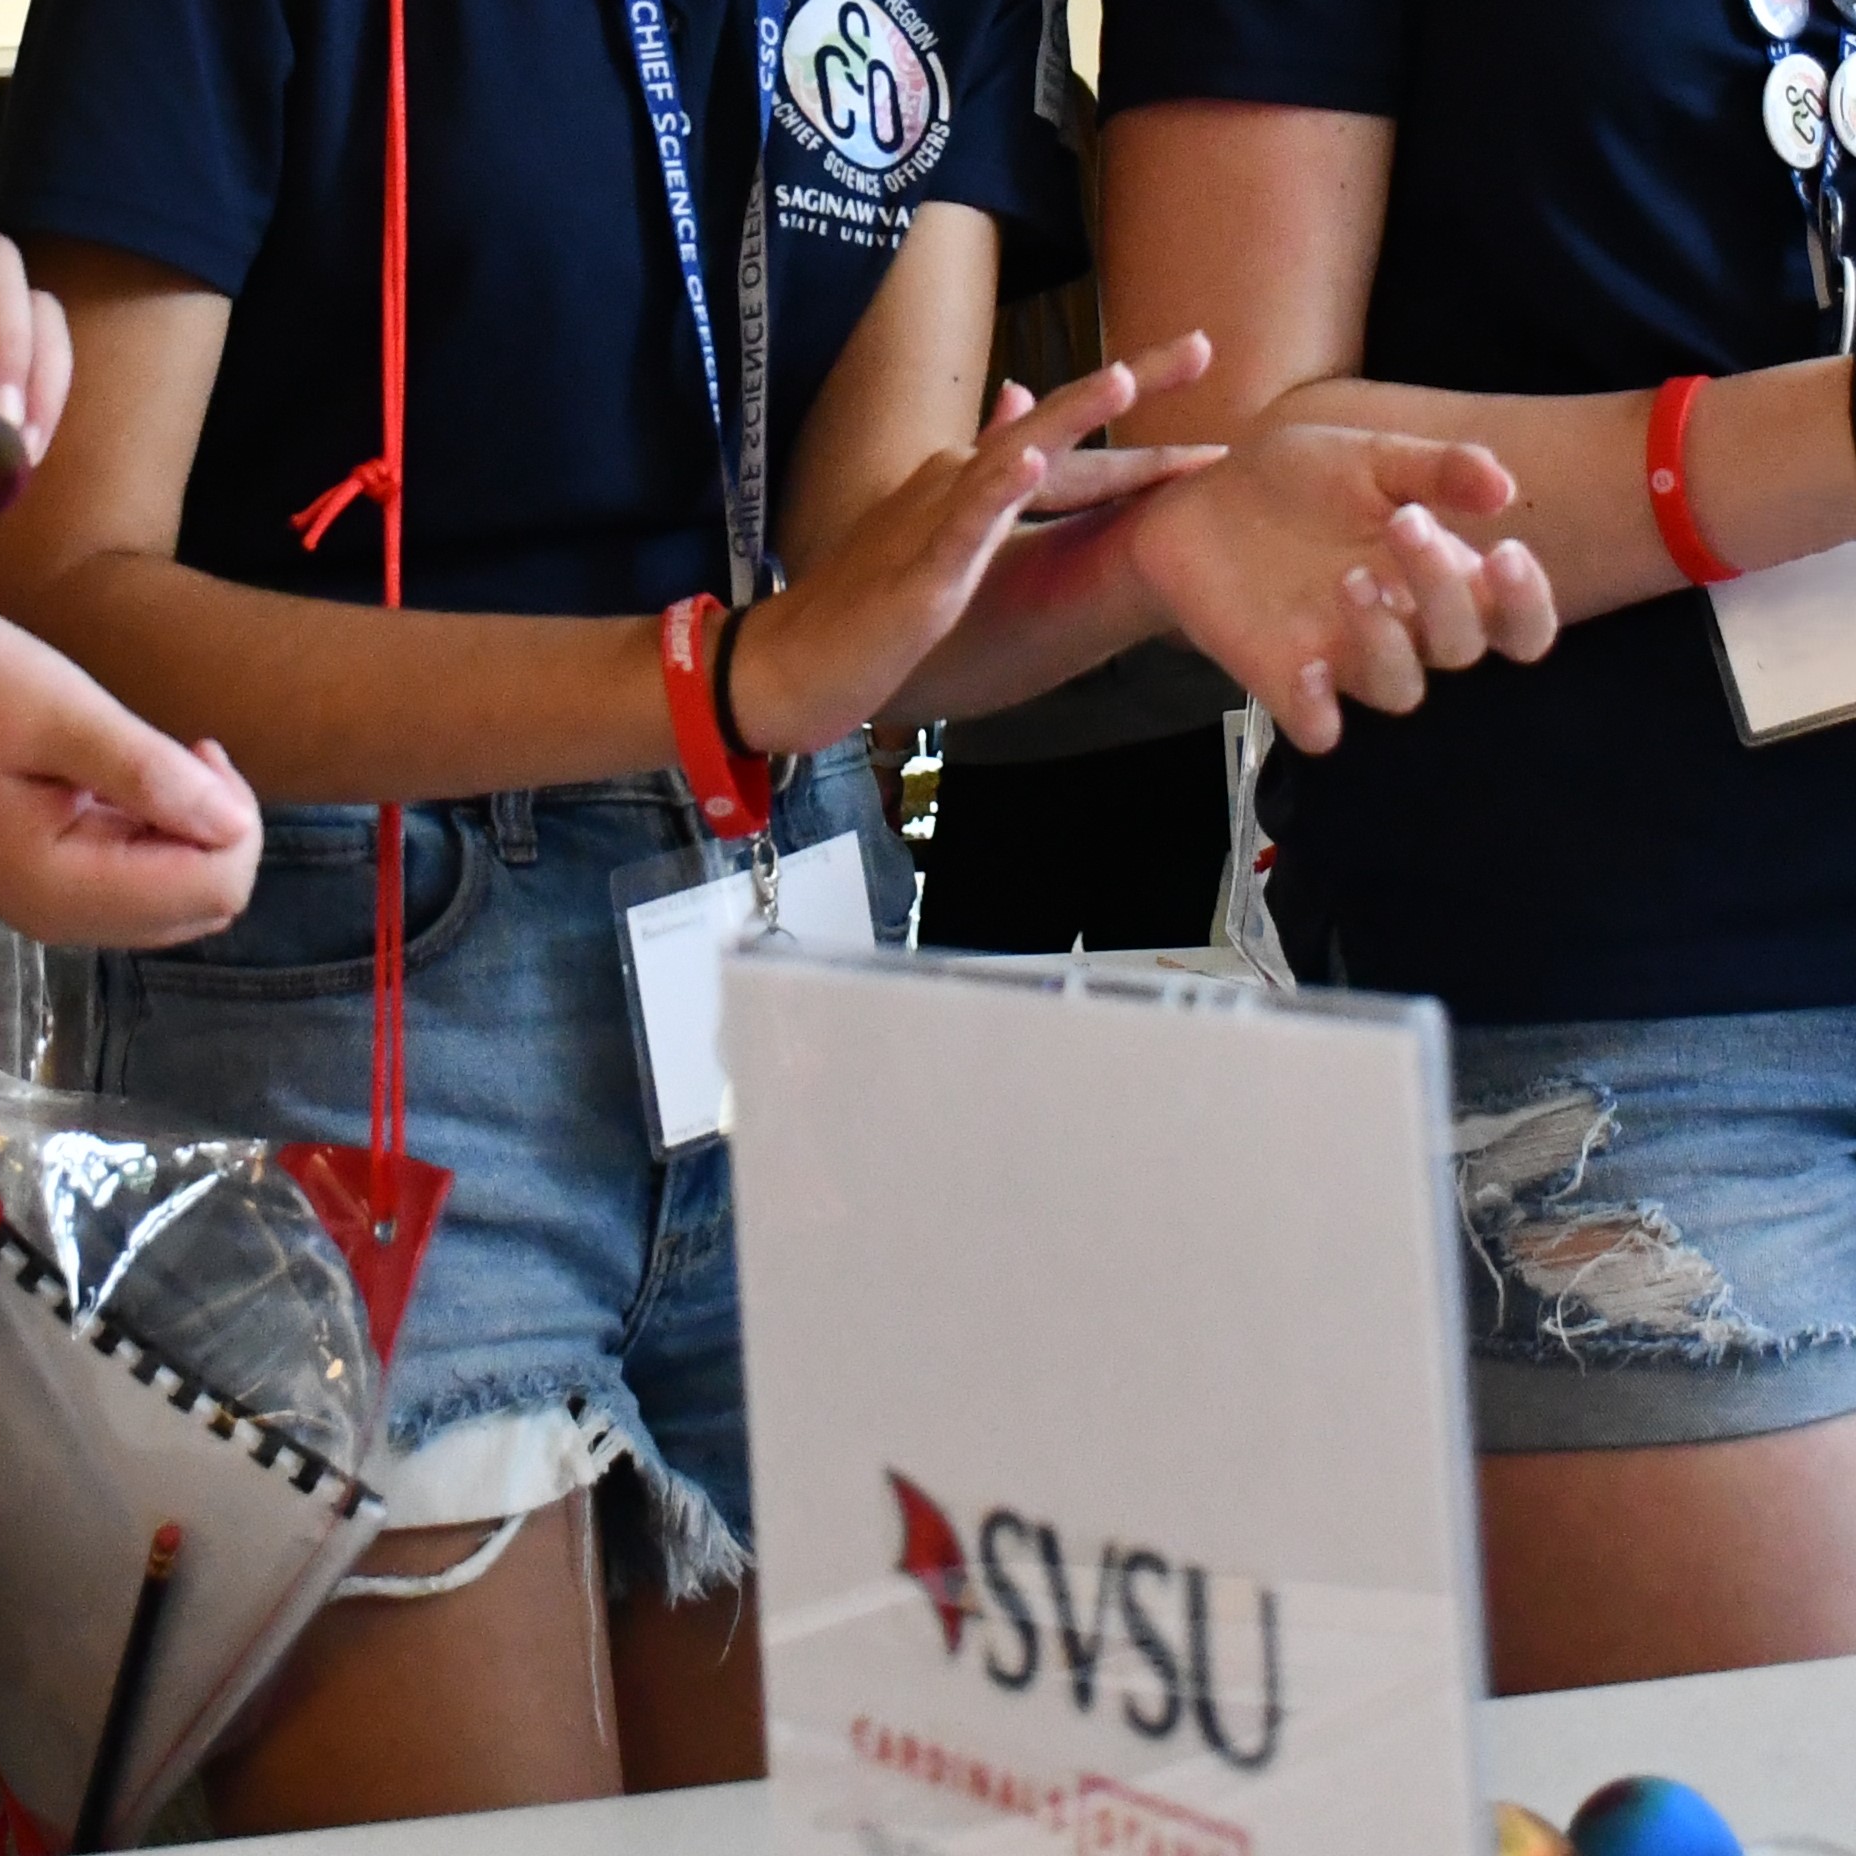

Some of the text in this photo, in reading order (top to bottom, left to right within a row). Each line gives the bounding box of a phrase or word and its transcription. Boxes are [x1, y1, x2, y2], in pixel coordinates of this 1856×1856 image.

[631, 0, 674, 102] CHIEF
[652, 111, 698, 263] SCIENCE
[773, 101, 951, 199] CHIEF SCIENCE OFFICERS
[775, 184, 877, 226] SAGINAW
[778, 212, 828, 237] STATE
[978, 1507, 1285, 1772] SVSU
